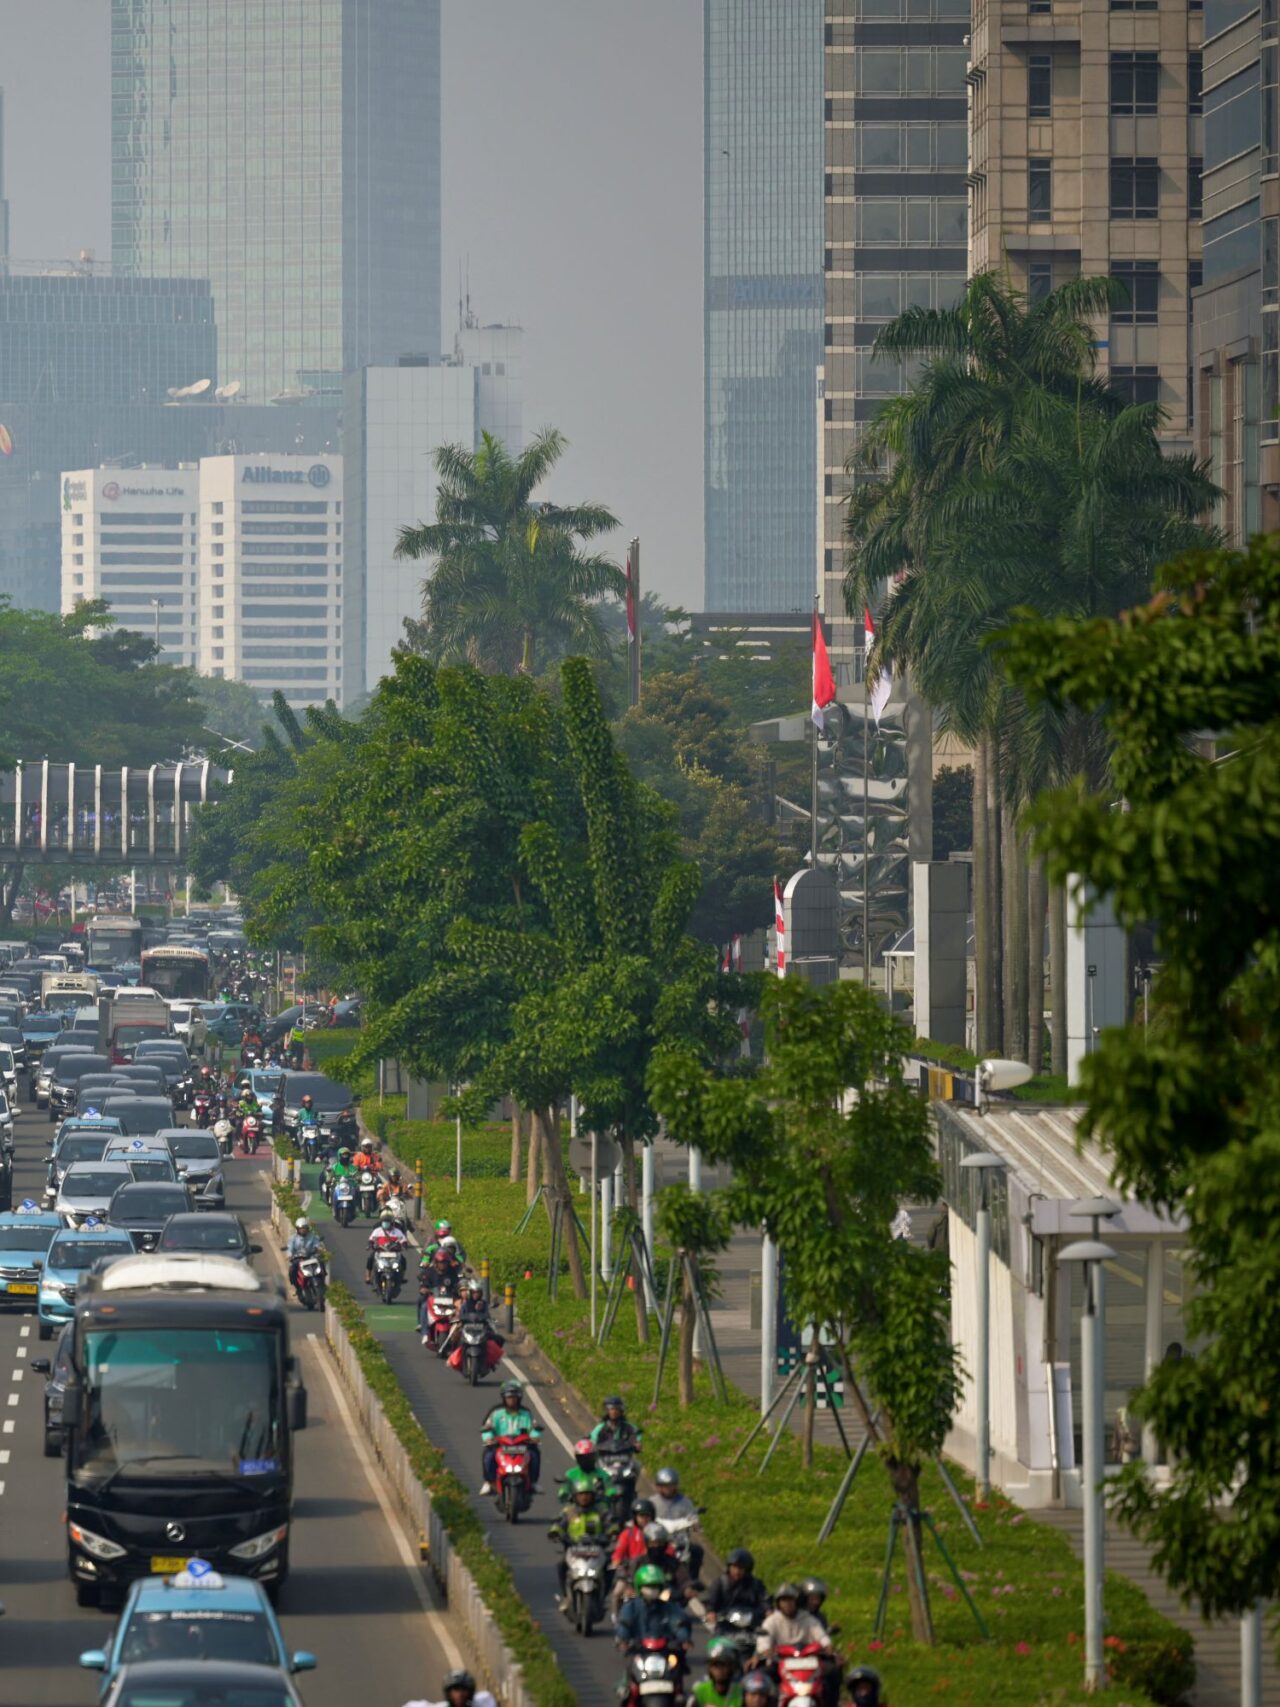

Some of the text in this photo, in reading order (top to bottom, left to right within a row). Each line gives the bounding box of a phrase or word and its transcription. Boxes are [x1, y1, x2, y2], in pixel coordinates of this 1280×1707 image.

[242, 466, 304, 483] Allianz
[122, 487, 185, 496] Hanwha Life
